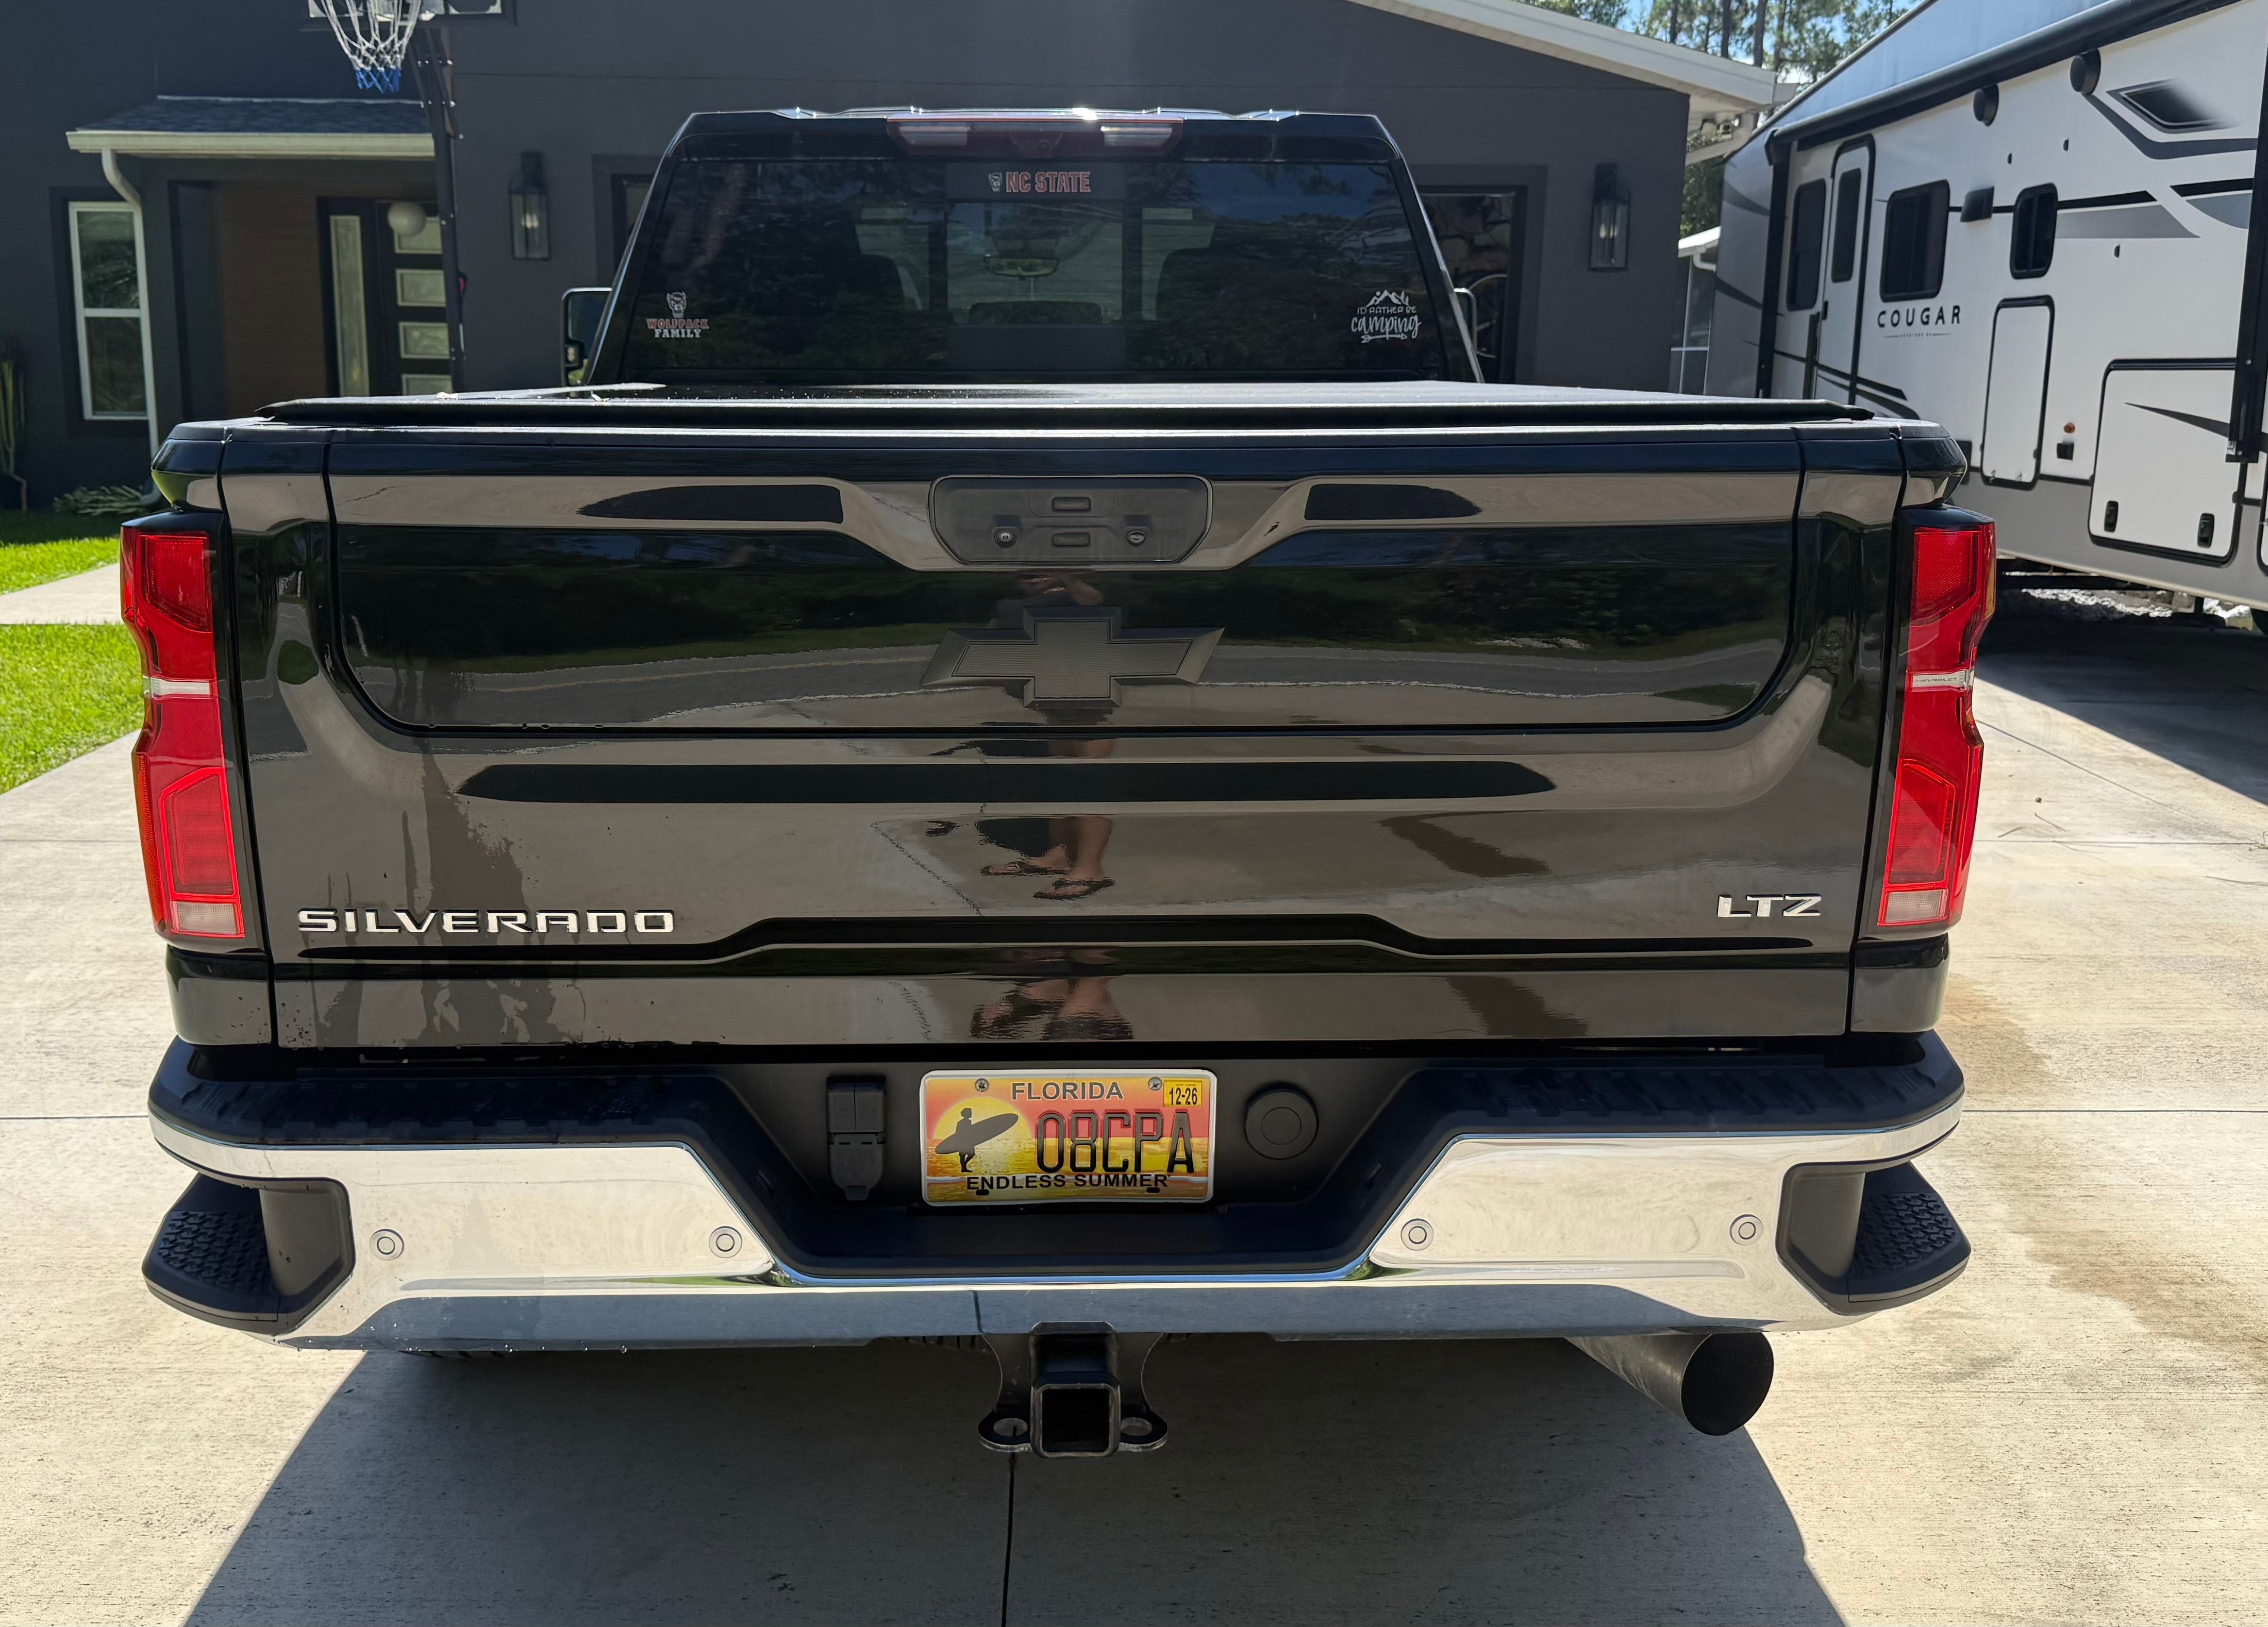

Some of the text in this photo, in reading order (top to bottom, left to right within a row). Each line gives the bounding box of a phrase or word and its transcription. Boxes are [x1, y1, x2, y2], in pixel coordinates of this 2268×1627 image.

[1006, 172, 1091, 192] NC STATE
[646, 318, 709, 329] WOLFPACK
[1877, 305, 1961, 328] COUGAR
[655, 329, 701, 338] FAMILY
[1351, 315, 1422, 340] camping
[1716, 894, 1822, 917] LTZ
[297, 908, 675, 933] SILVERADO
[1011, 1082, 1124, 1100] FLORIDA
[1169, 1087, 1197, 1105] 12-26
[966, 1173, 1168, 1190] ENDLESS SUMMER
